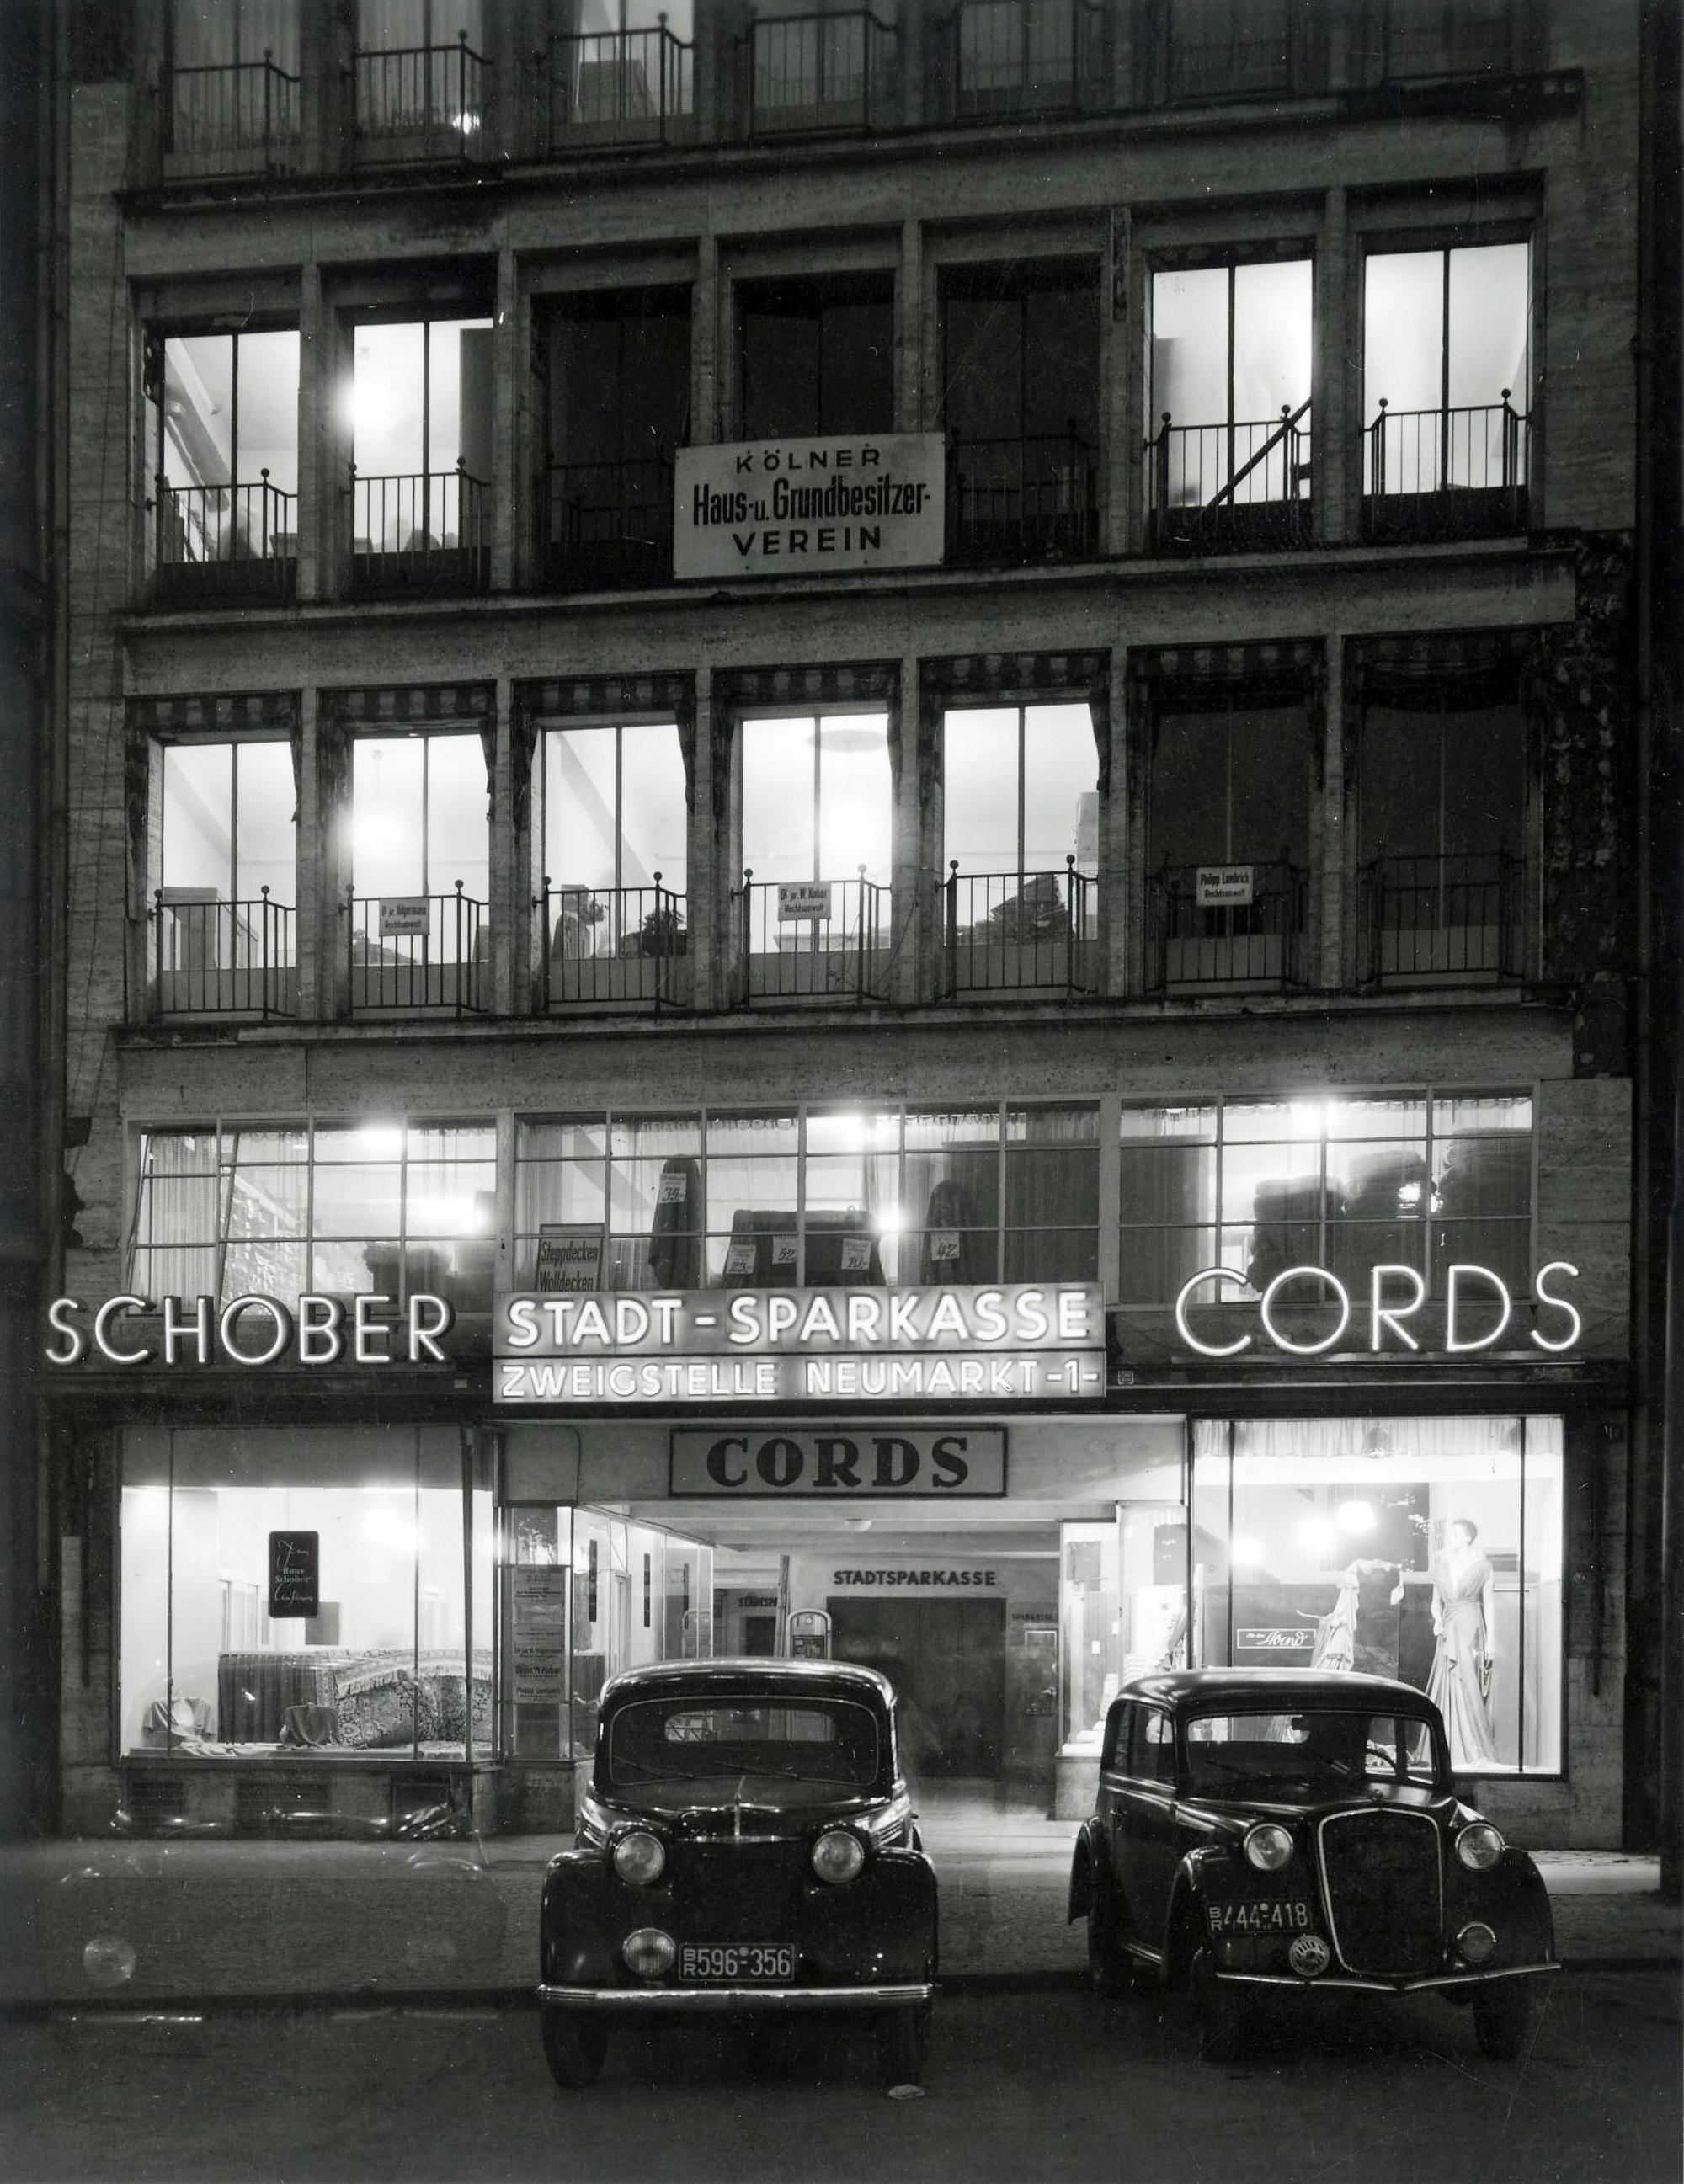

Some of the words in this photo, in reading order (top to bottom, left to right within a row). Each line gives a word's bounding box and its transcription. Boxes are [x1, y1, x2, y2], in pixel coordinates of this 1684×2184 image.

[735, 447, 881, 474] KÖLNER
[772, 473, 931, 520] Grundbesitzer-
[732, 526, 881, 557] VEREIN
[541, 1240, 599, 1266] Steppdecken
[540, 1270, 594, 1292] Wolldecken
[507, 1297, 683, 1347] STADT
[728, 1292, 1089, 1345] SPARKASSE
[1175, 1261, 1580, 1356] CORDS
[46, 1295, 454, 1365] SCHOBER
[502, 1362, 778, 1398] ZWEIGSTELLE
[806, 1359, 1037, 1396] NEUMARKT
[706, 1436, 969, 1488] CORDS
[834, 1569, 996, 1586] STADTSPARKASSE
[697, 1947, 791, 1977] 596-356
